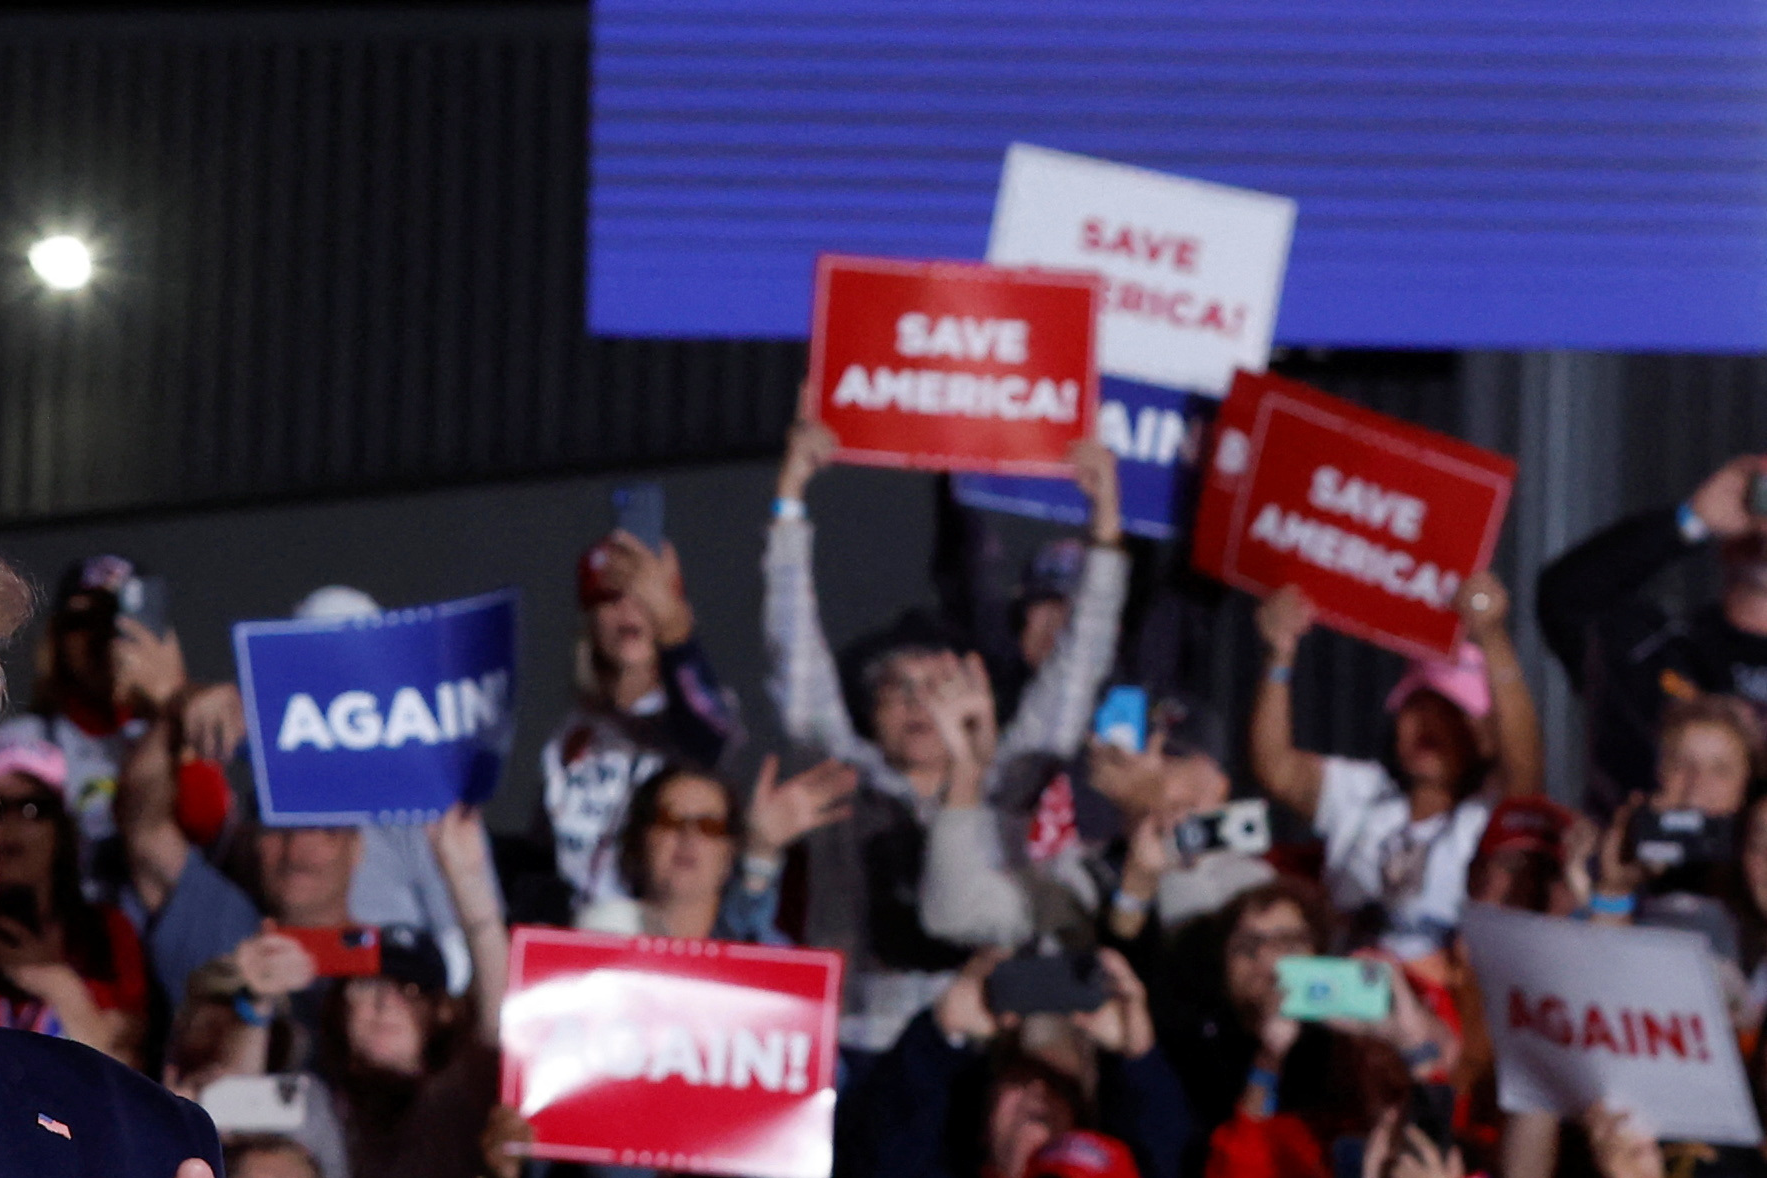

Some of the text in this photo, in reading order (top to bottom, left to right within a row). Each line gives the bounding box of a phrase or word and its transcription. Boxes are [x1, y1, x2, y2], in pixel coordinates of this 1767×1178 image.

[1080, 217, 1201, 273] SAVE
[895, 311, 1030, 365] SAVE
[834, 364, 1079, 423] AMERICA!
[1098, 400, 1200, 467] AIN
[1308, 464, 1428, 543] SAVE
[1506, 984, 1712, 1067] AGAIN!
